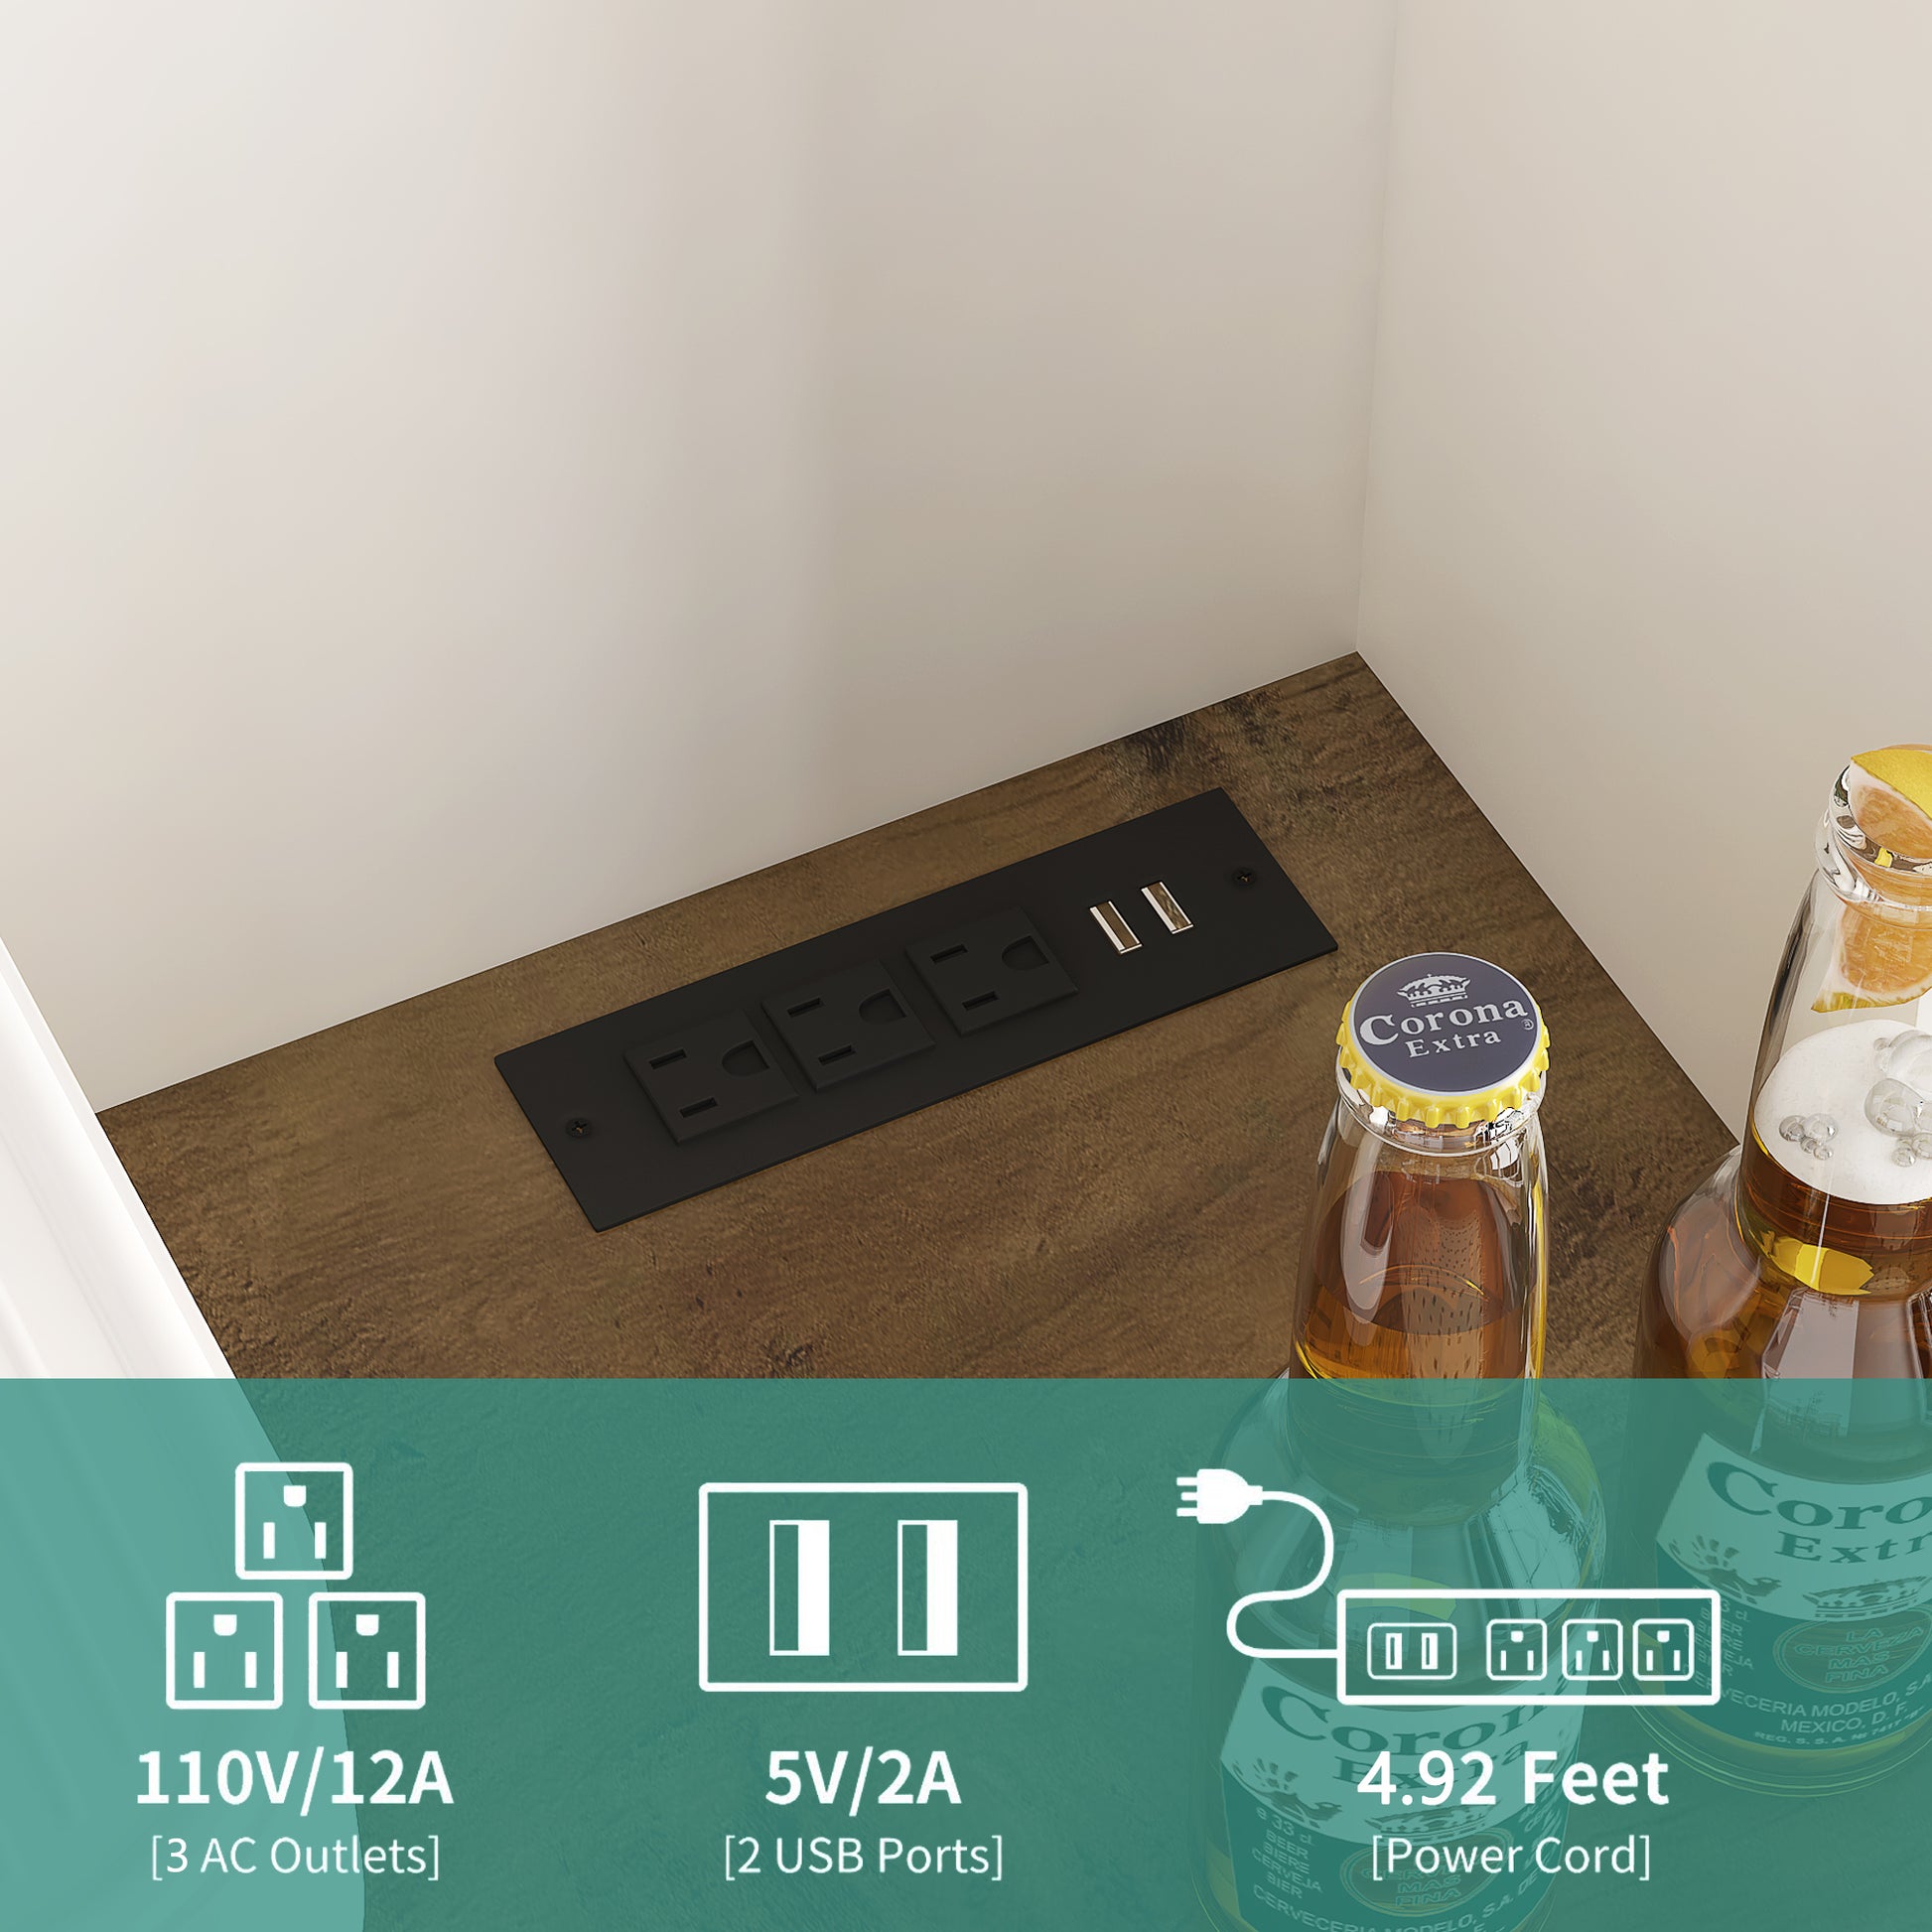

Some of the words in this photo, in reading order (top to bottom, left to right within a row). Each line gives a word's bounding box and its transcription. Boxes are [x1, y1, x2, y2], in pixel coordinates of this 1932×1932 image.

[1359, 999, 1529, 1045] Corona
[1405, 1029, 1502, 1058] Extra
[1700, 1607, 1744, 1637] BER
[1824, 1664, 1889, 1684] FINA
[1827, 1650, 1890, 1670] MAS
[1780, 1718, 1866, 1733] MEXICO,
[1262, 1841, 1311, 1875] BIERE
[1265, 1828, 1310, 1861] BEER
[1265, 1870, 1304, 1899] BIER
